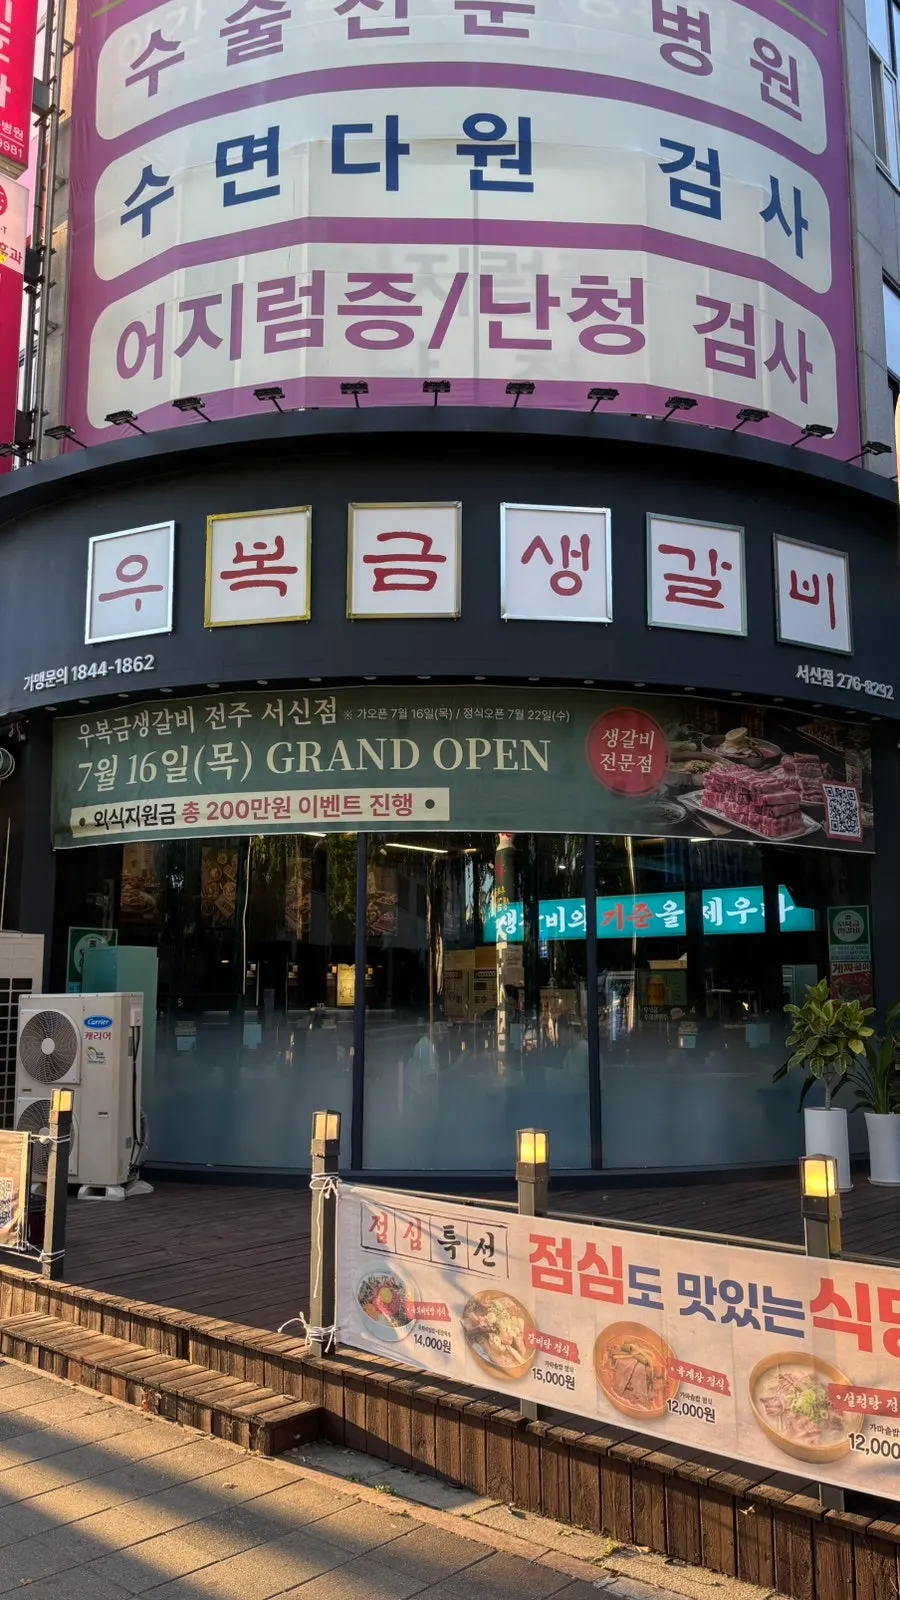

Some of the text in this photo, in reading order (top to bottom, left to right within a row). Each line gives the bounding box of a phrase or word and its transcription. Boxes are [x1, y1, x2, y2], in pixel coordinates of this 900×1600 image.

[650, 0, 802, 122] 병원
[120, 113, 809, 259] 수면다원 검사
[116, 270, 646, 380] 어지럼증/난청
[692, 294, 813, 405] 검사
[23, 654, 155, 692] 가맹문의 1844-1862
[795, 664, 895, 700] 서신점 276-8292
[77, 695, 336, 748] 우복금생갈비 전주 서신점
[357, 708, 388, 720] 가오픈
[391, 708, 408, 720] 7월
[411, 708, 453, 721] 16일(목)
[463, 708, 504, 720] 정식오픈
[508, 709, 524, 721] 7월
[528, 709, 570, 722] 22일(수)
[601, 728, 655, 751] 생갈비
[77, 737, 551, 792] 7월 16일(목) GRAND OPEN
[600, 753, 652, 774] 전문점
[94, 793, 413, 830] 외식지원금 총 200만원 이벤트 진행
[496, 905, 587, 934] 생비의
[601, 899, 684, 931] 기준을
[84, 1031, 112, 1040] 캐리어
[87, 1018, 110, 1026] Carrier
[529, 1233, 664, 1311] 점심도
[414, 1333, 451, 1354] 14,000원
[532, 1368, 575, 1390] 15,000원
[666, 1399, 715, 1424] 12,000원
[843, 1391, 882, 1411] 설렁탕
